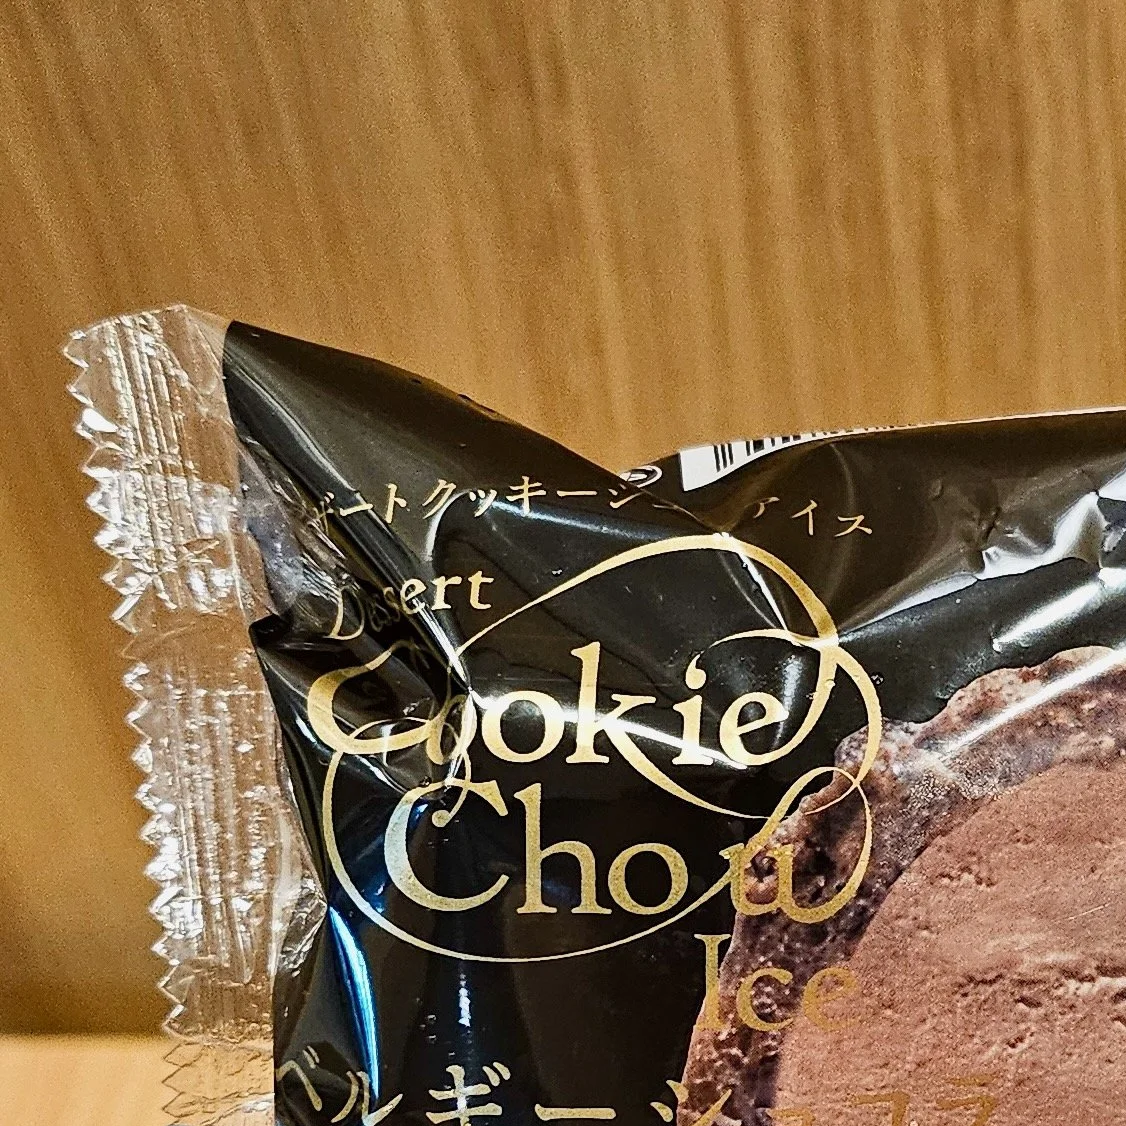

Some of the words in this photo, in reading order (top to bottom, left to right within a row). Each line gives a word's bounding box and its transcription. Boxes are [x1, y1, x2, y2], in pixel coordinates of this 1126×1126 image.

[306, 640, 800, 770] Cookie
[384, 778, 815, 924] Chou
[692, 933, 862, 1031] Ice
